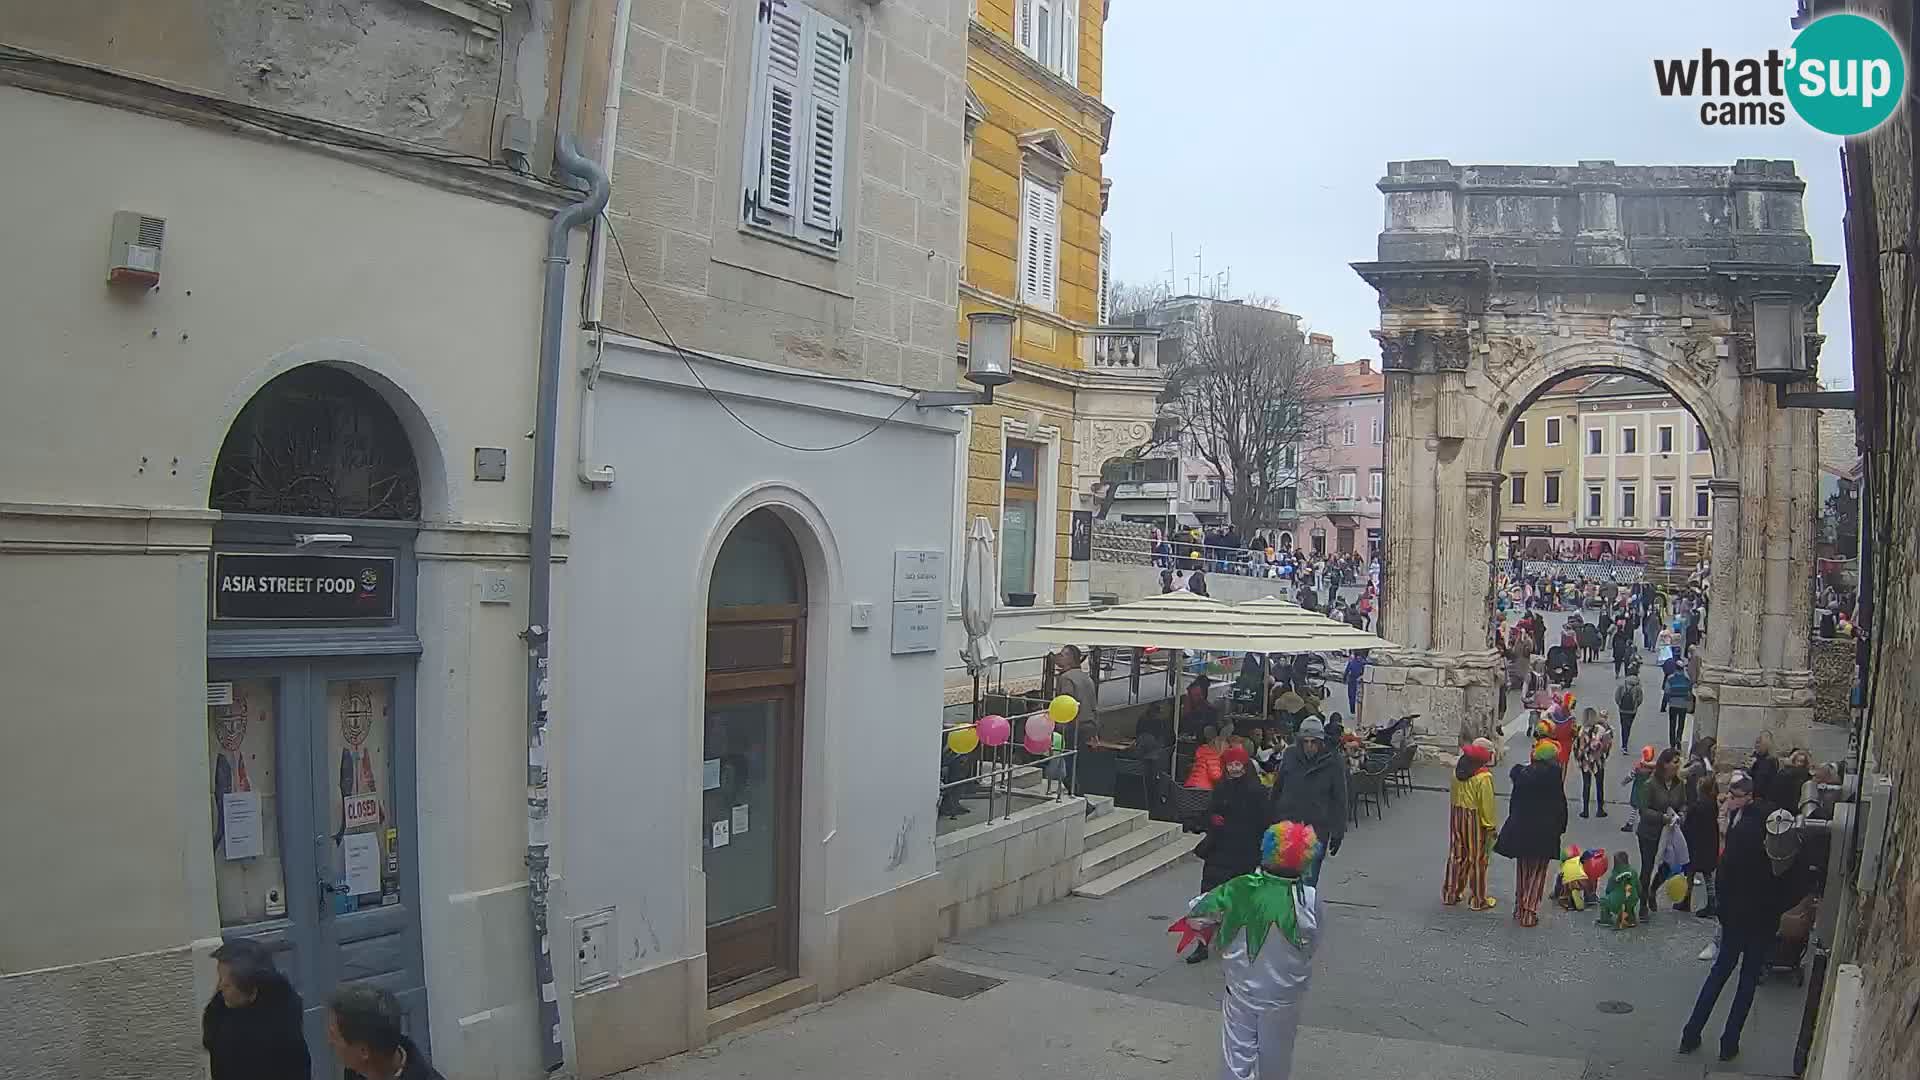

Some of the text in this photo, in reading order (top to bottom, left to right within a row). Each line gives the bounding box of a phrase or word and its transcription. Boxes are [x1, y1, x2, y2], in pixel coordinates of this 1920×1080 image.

[221, 575, 356, 593] ASIA STREET FOOD
[347, 799, 376, 820] CLOSED
